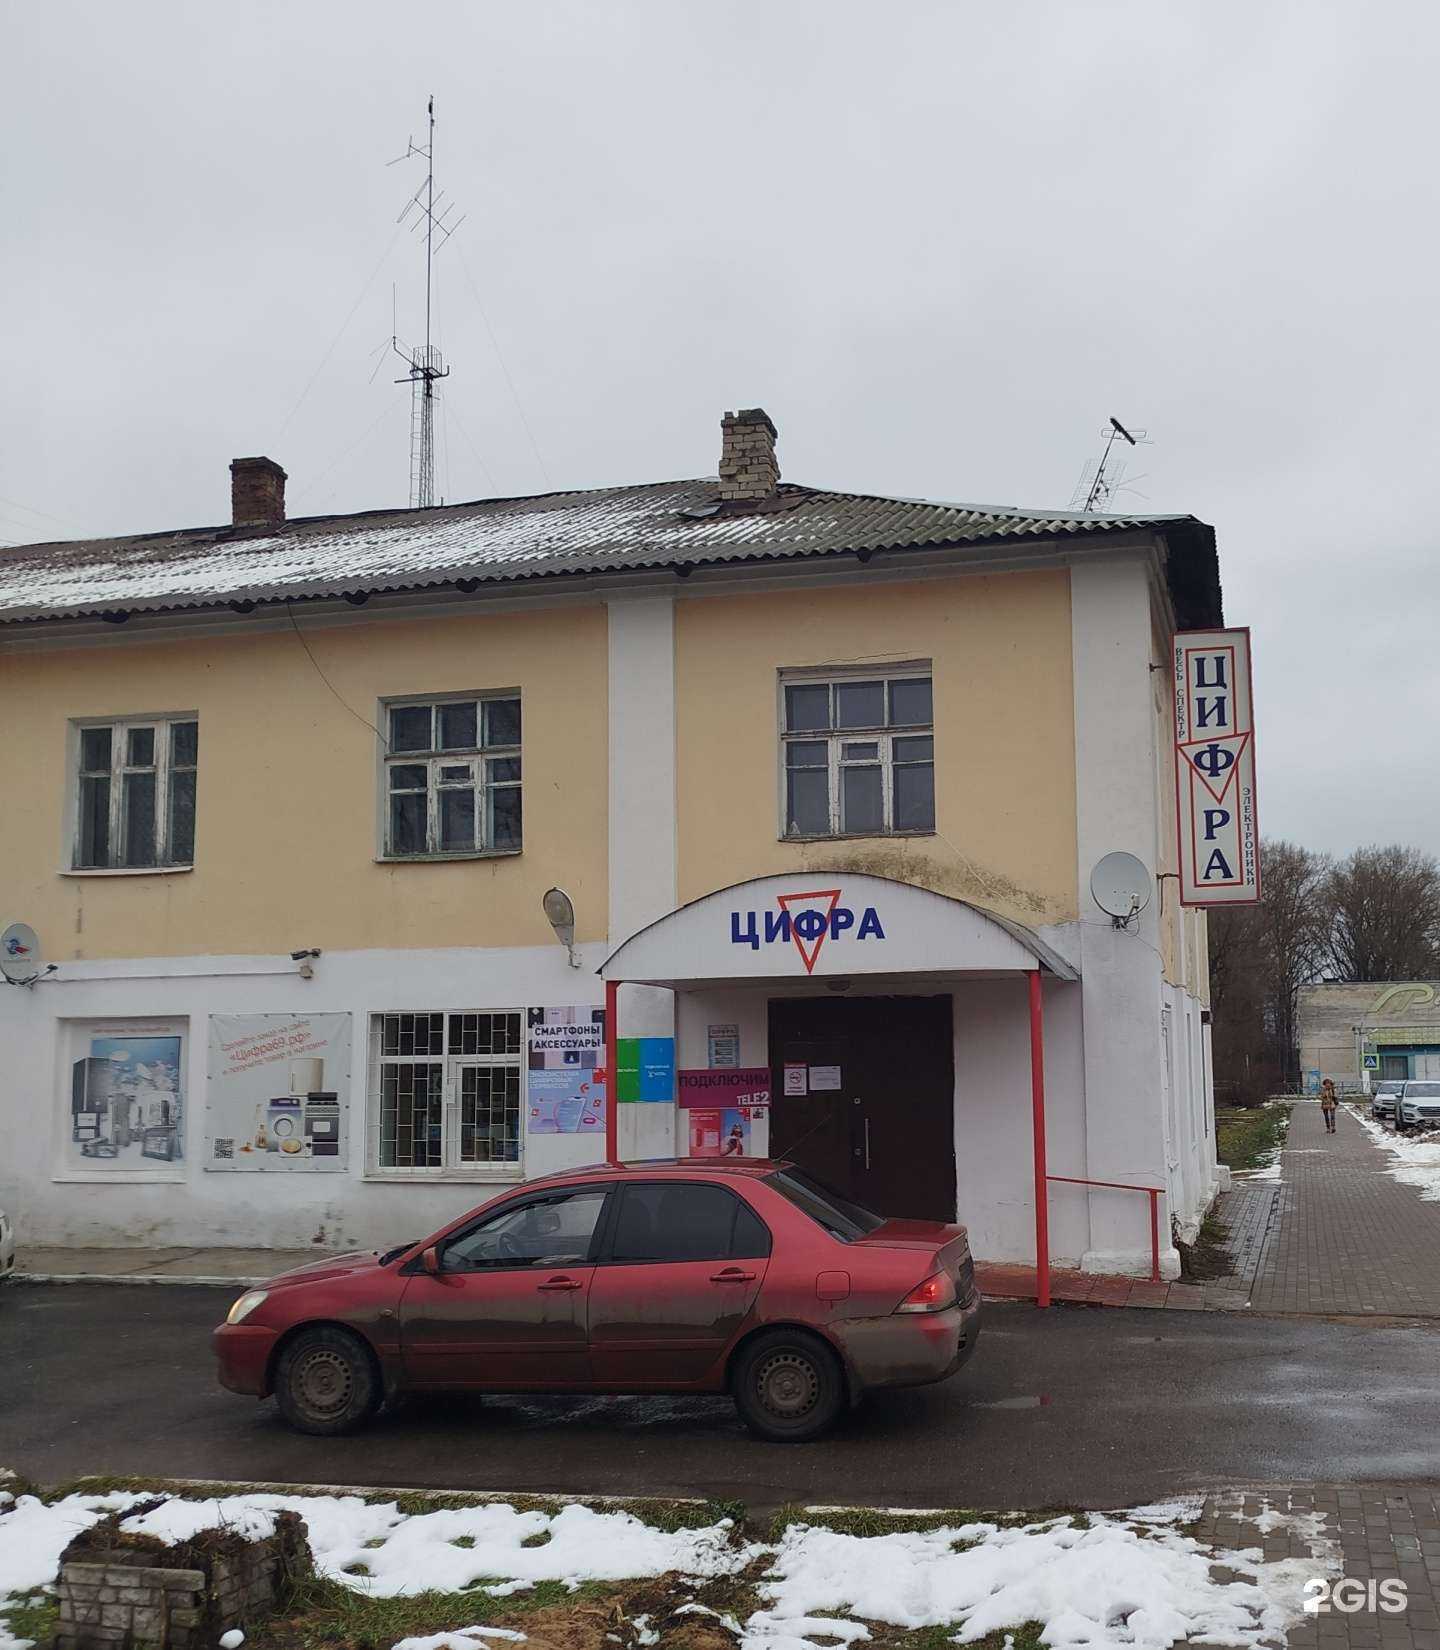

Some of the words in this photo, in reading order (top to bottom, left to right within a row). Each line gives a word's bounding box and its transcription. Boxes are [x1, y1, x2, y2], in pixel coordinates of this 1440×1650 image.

[1175, 648, 1184, 681] ВЕСЬ
[1176, 689, 1186, 739] СПЕКТР
[1193, 655, 1235, 880] ЦИФРА
[1243, 787, 1256, 887] ЭЛЕКТРОНИКИ
[731, 907, 885, 950] ЦИФРА
[534, 1025, 600, 1036] СМАРТФОНЫ
[534, 1038, 601, 1049] АКСЕССУАРЫ
[679, 1073, 769, 1089] ПОДКЛЮЧИМ
[736, 1090, 769, 1106] TELE2
